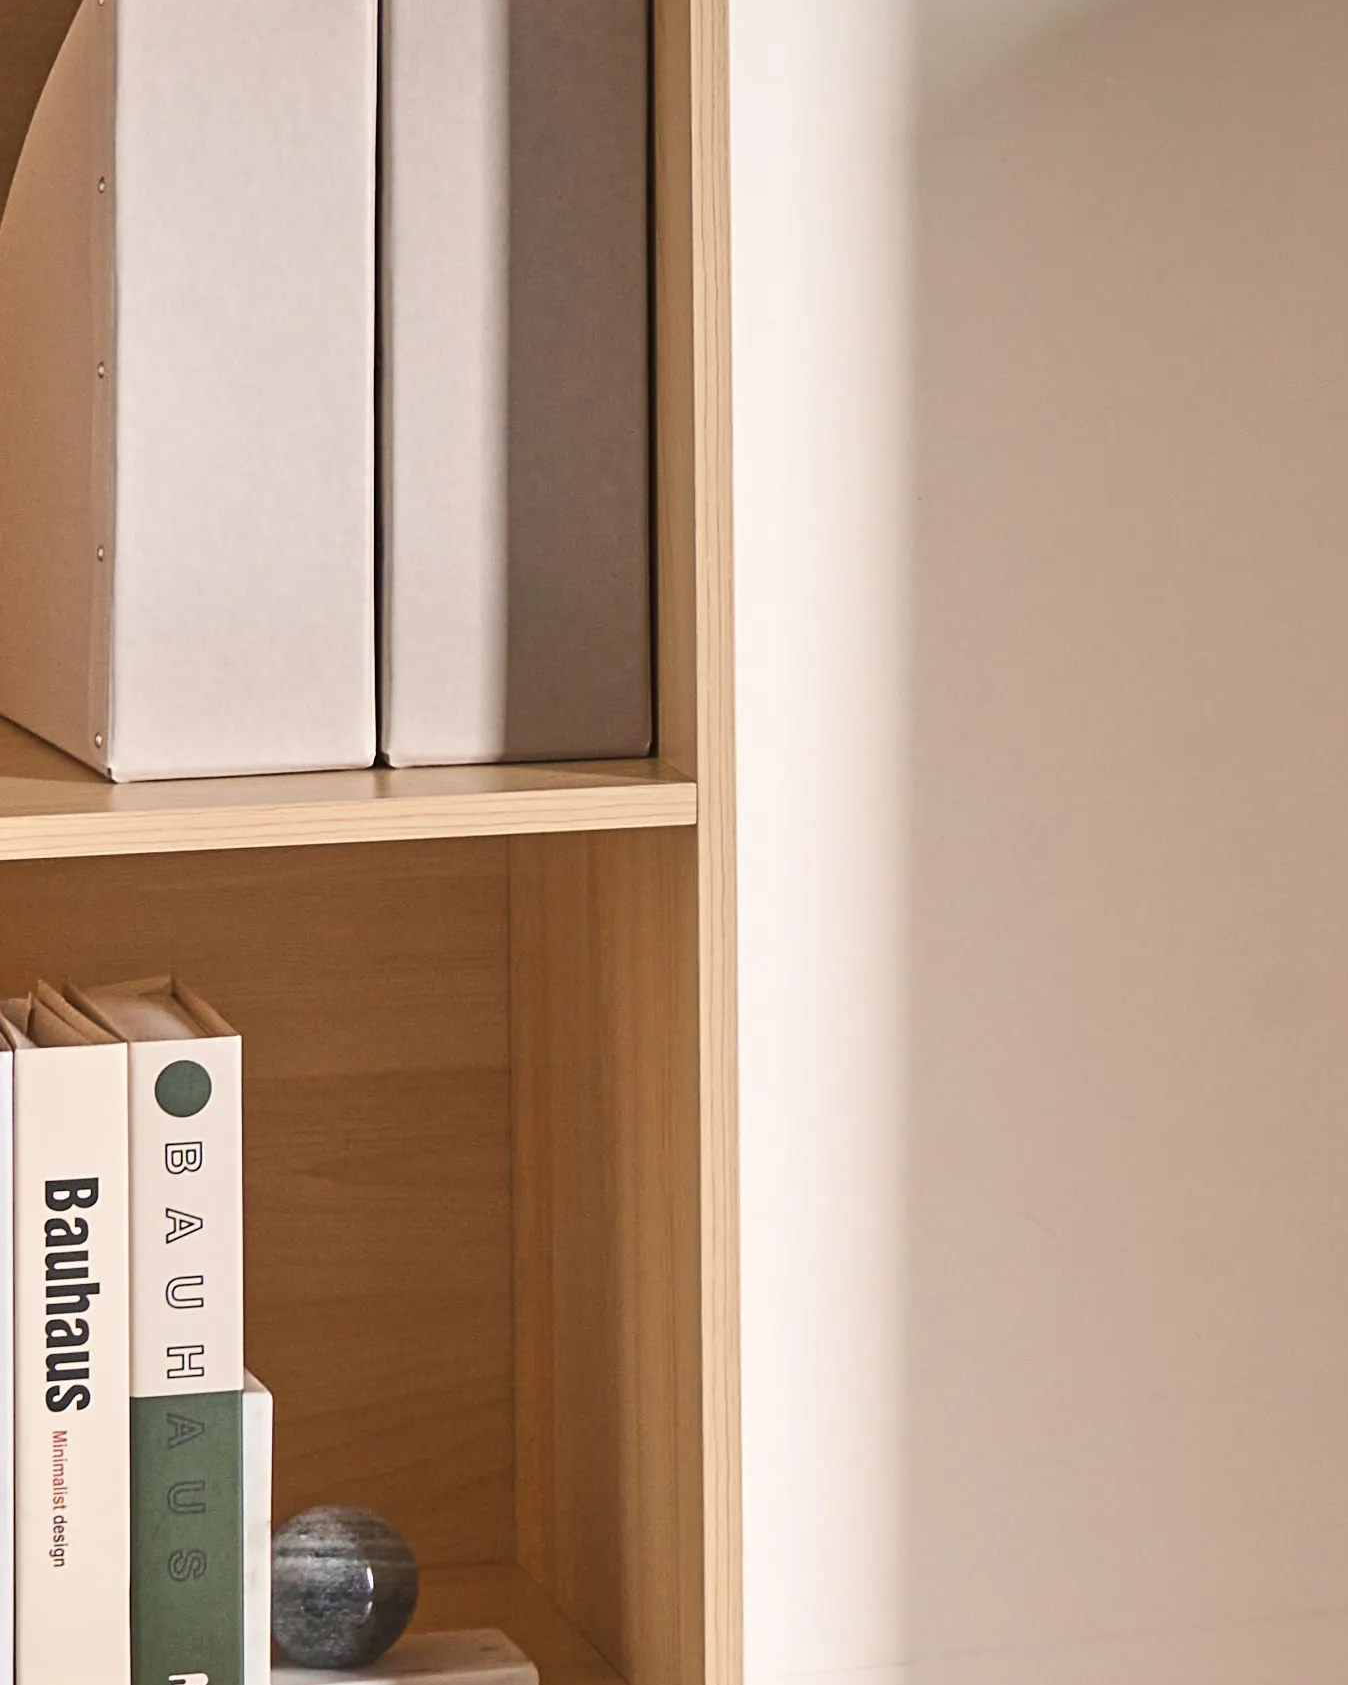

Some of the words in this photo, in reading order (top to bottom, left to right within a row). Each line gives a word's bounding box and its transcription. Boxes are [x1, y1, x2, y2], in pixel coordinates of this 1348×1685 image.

[44, 1177, 100, 1412] Bauhaus
[163, 1141, 208, 1584] BAUHAUS
[49, 1515, 68, 1568] design
[52, 1430, 68, 1511] Minimalist
